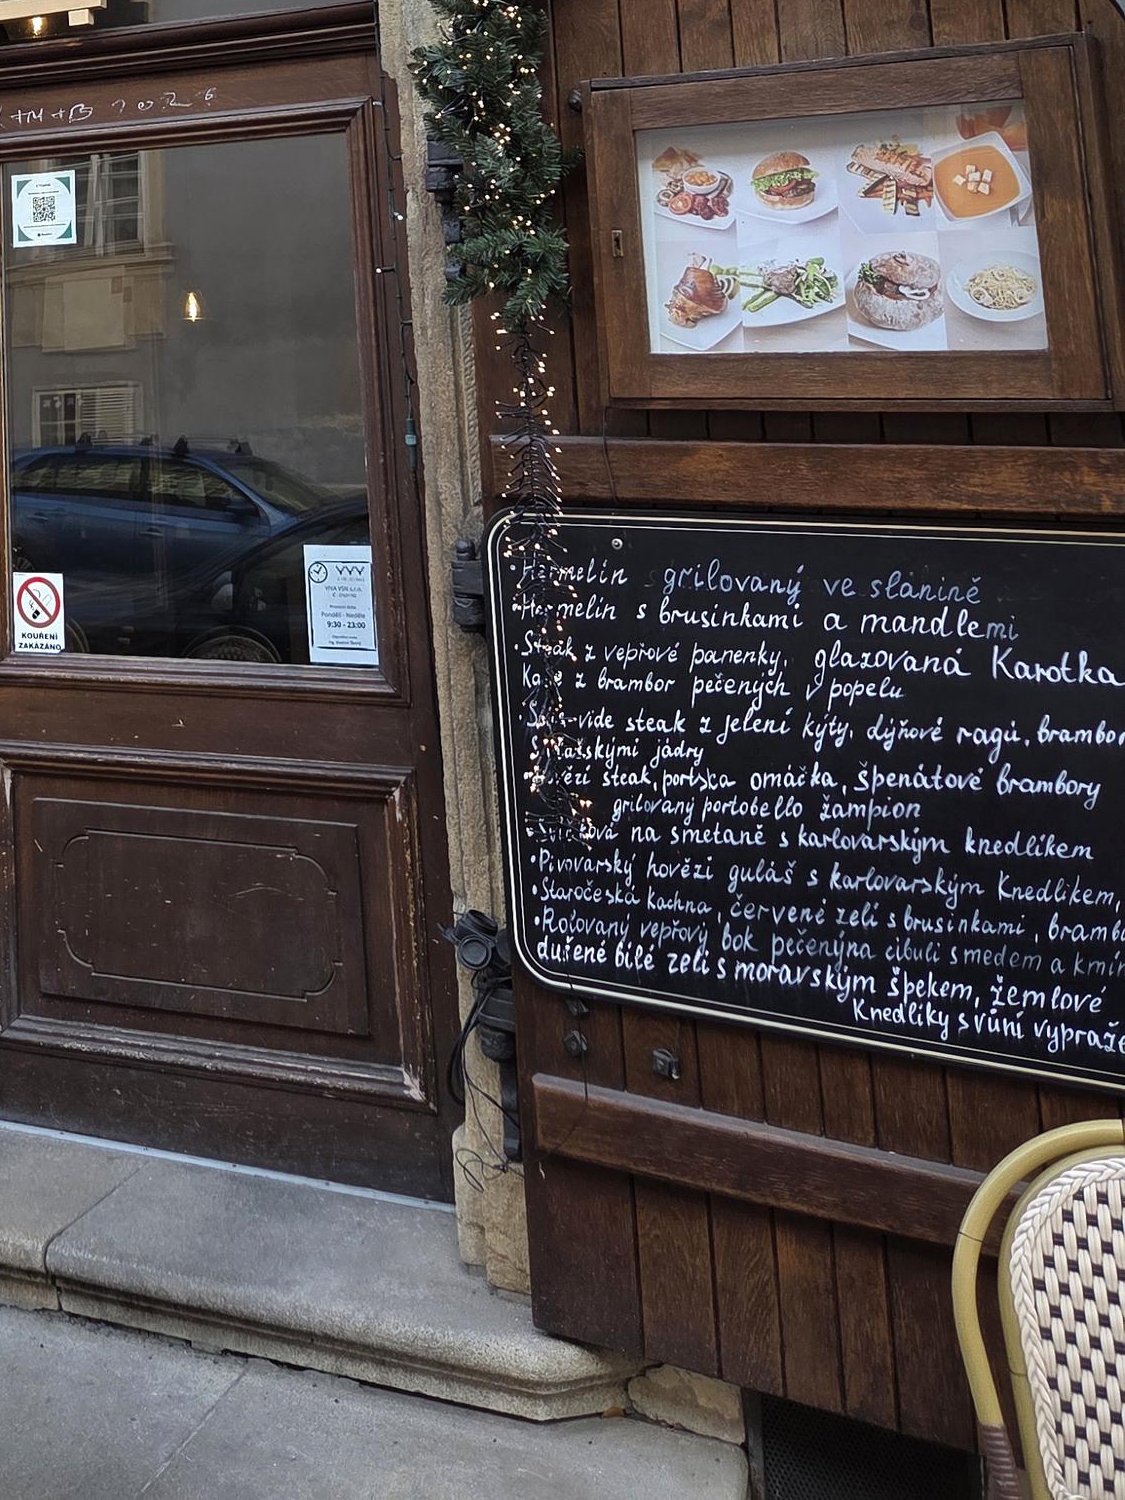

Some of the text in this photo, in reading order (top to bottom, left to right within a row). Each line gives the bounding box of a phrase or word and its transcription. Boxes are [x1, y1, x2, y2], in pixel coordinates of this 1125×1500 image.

[823, 576, 855, 597] ve
[636, 602, 647, 619] s
[659, 596, 803, 629] brusinkami
[824, 612, 848, 631] a
[597, 666, 676, 693] brambor
[828, 676, 904, 711] popelu
[625, 707, 686, 733] steak
[996, 762, 1101, 810] brambory
[631, 827, 661, 843] na
[670, 825, 767, 845] smetaně
[779, 831, 789, 847] s
[806, 867, 818, 886] s
[887, 911, 896, 929] s
[722, 922, 759, 952] bok
[717, 957, 726, 980] s
